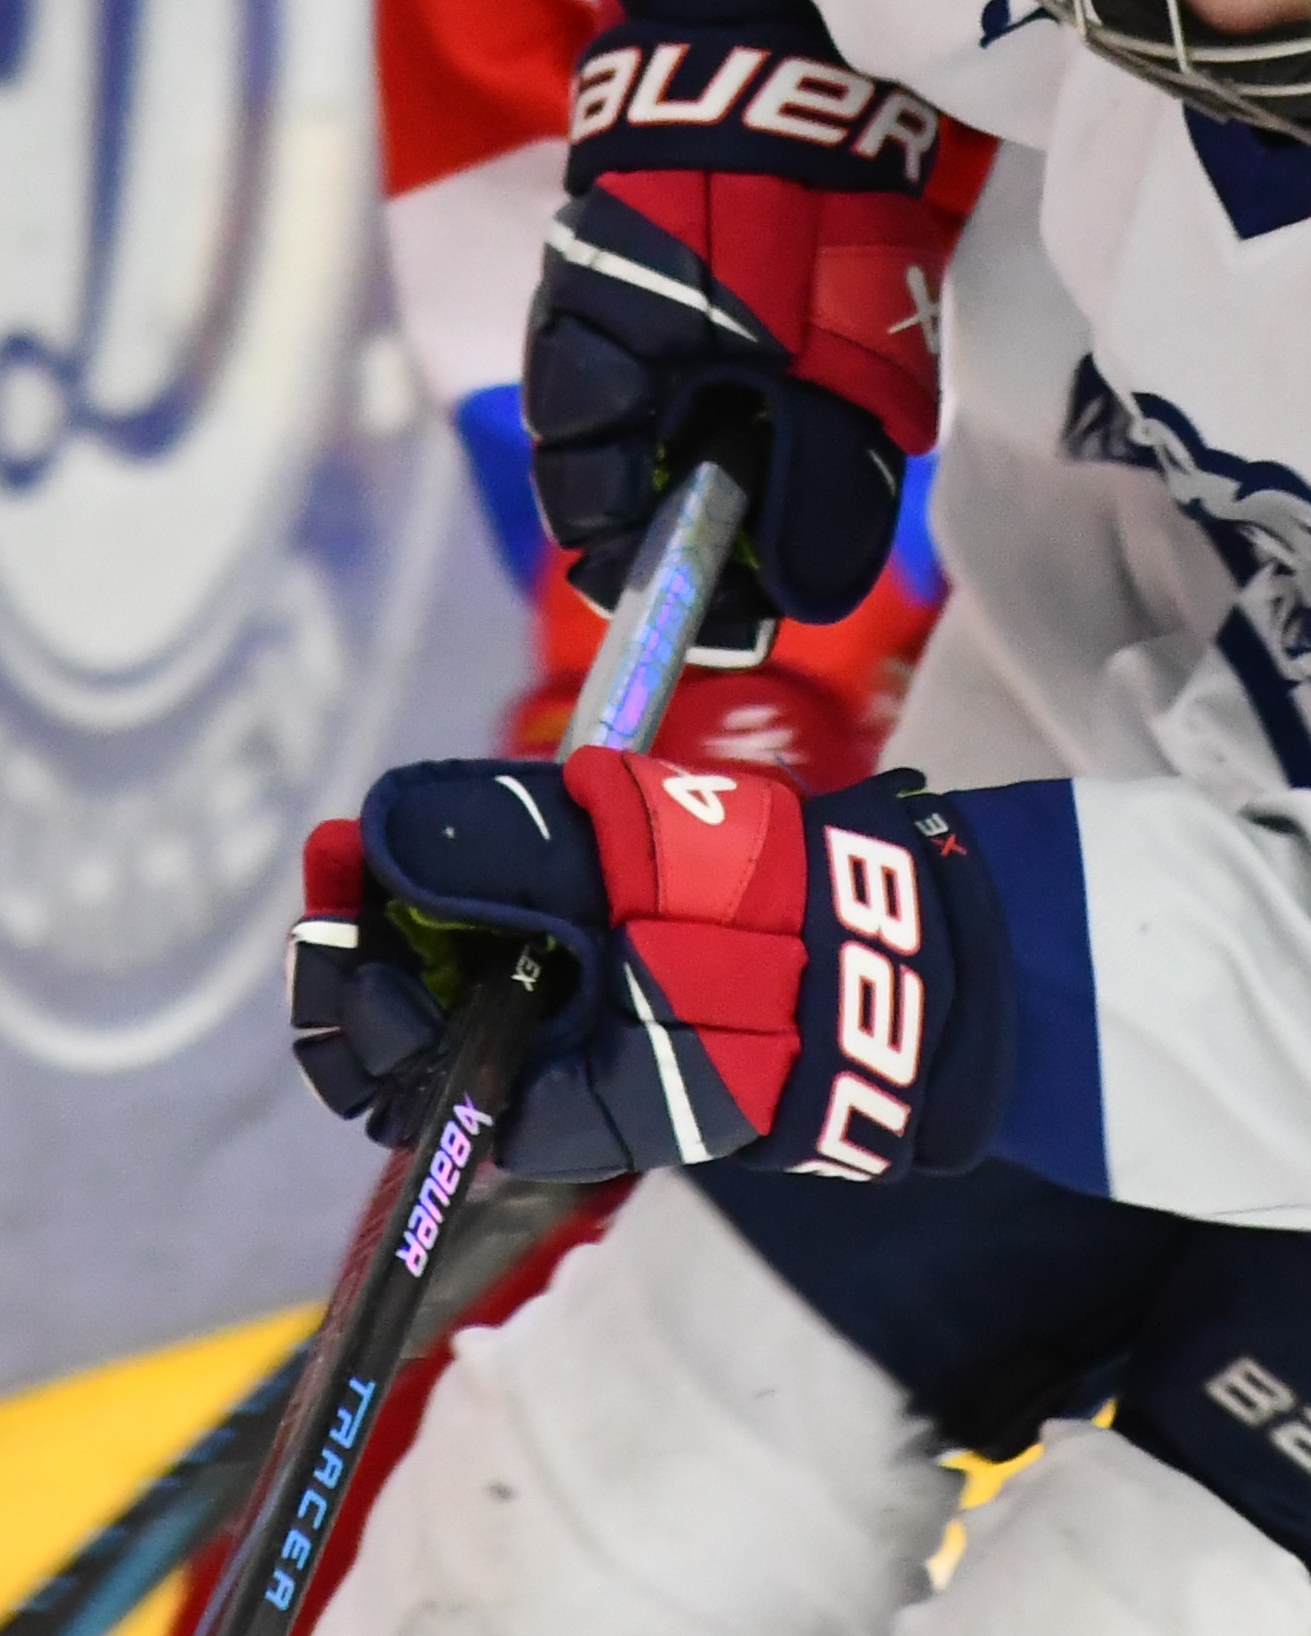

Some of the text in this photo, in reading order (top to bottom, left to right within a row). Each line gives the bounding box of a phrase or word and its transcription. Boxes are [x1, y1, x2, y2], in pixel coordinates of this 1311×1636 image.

[568, 42, 942, 186] AUER
[395, 1120, 473, 1278] BAUER
[264, 1376, 376, 1611] TRACER
